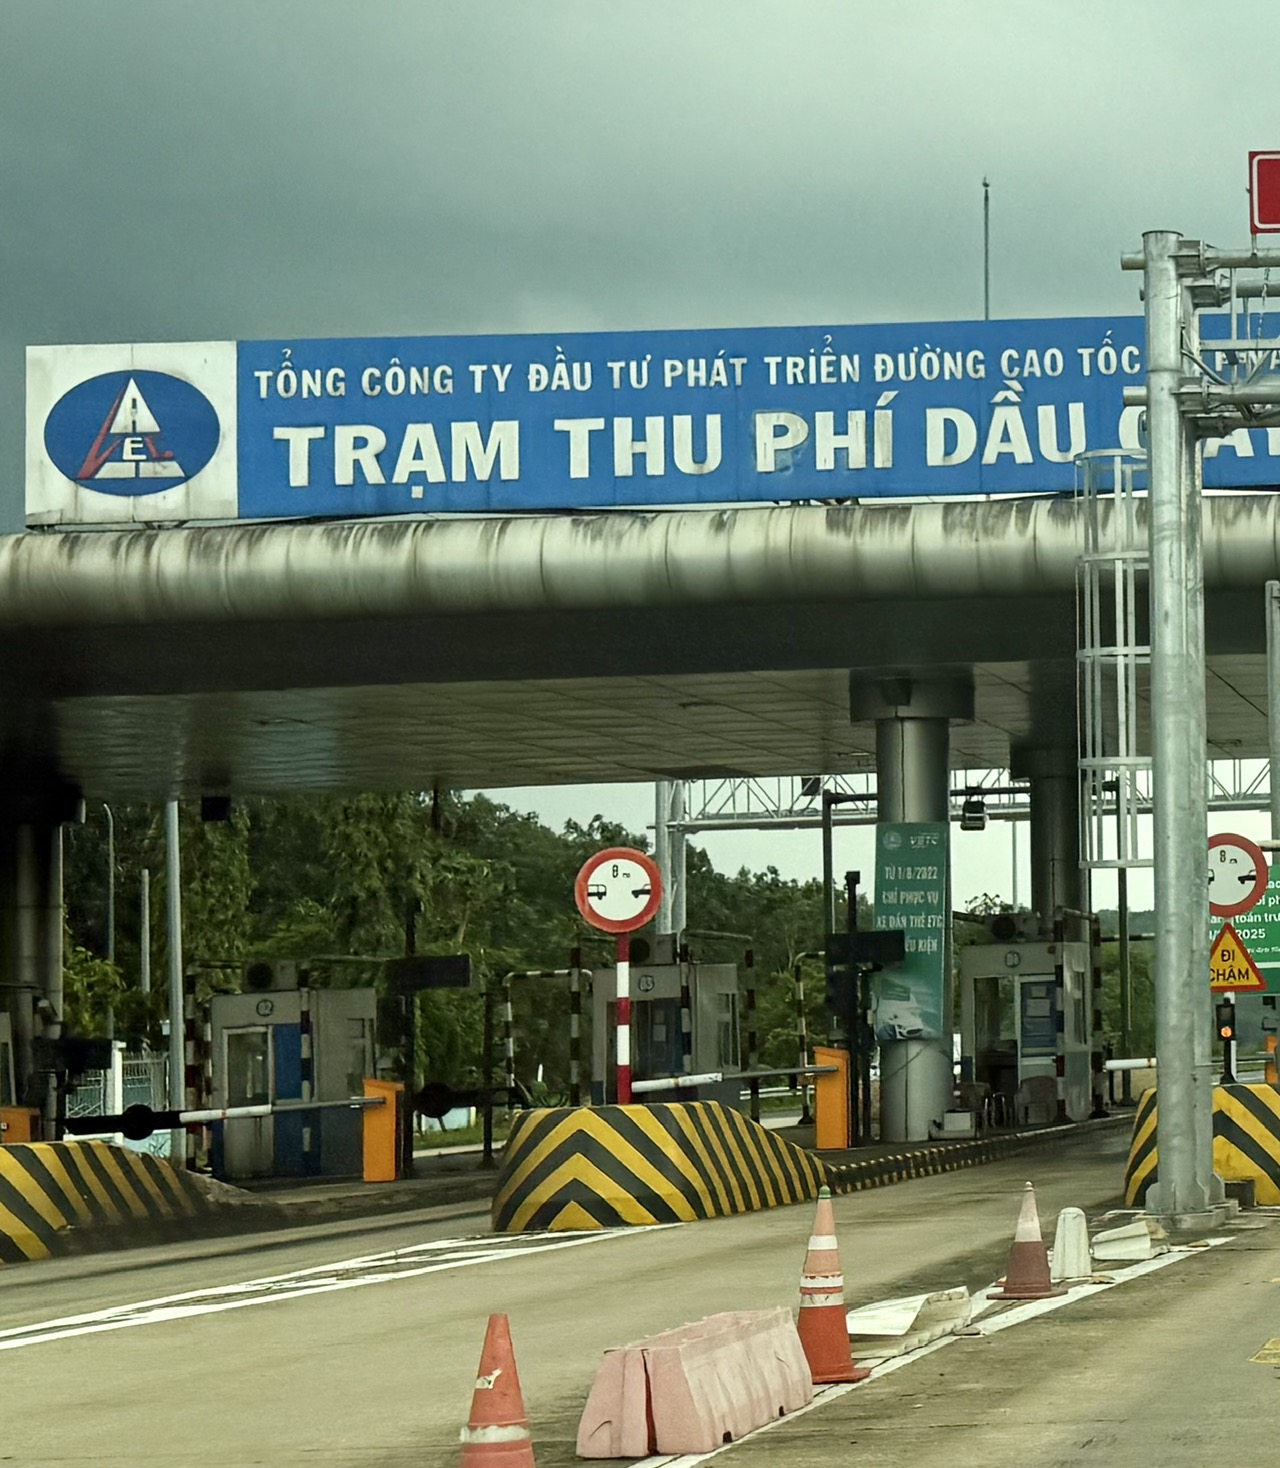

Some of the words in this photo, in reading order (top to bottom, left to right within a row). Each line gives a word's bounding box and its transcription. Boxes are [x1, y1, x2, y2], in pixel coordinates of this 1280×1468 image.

[254, 348, 345, 399] TỔNG
[361, 357, 453, 396] CÔNG
[468, 363, 512, 393] TY
[528, 345, 592, 392] ĐẦU
[607, 353, 652, 389] TƯ
[664, 350, 748, 388] PHÁT
[764, 334, 859, 385] TRIỂN
[874, 343, 986, 382] ĐƯỜNG
[1000, 348, 1064, 378] CAO
[1076, 330, 1141, 376] TỐC
[273, 420, 519, 499] TRẠM
[554, 412, 722, 479] THU
[755, 390, 899, 473] PHÍ
[925, 379, 1088, 467] DẦU
[1221, 949, 1235, 962] ĐI
